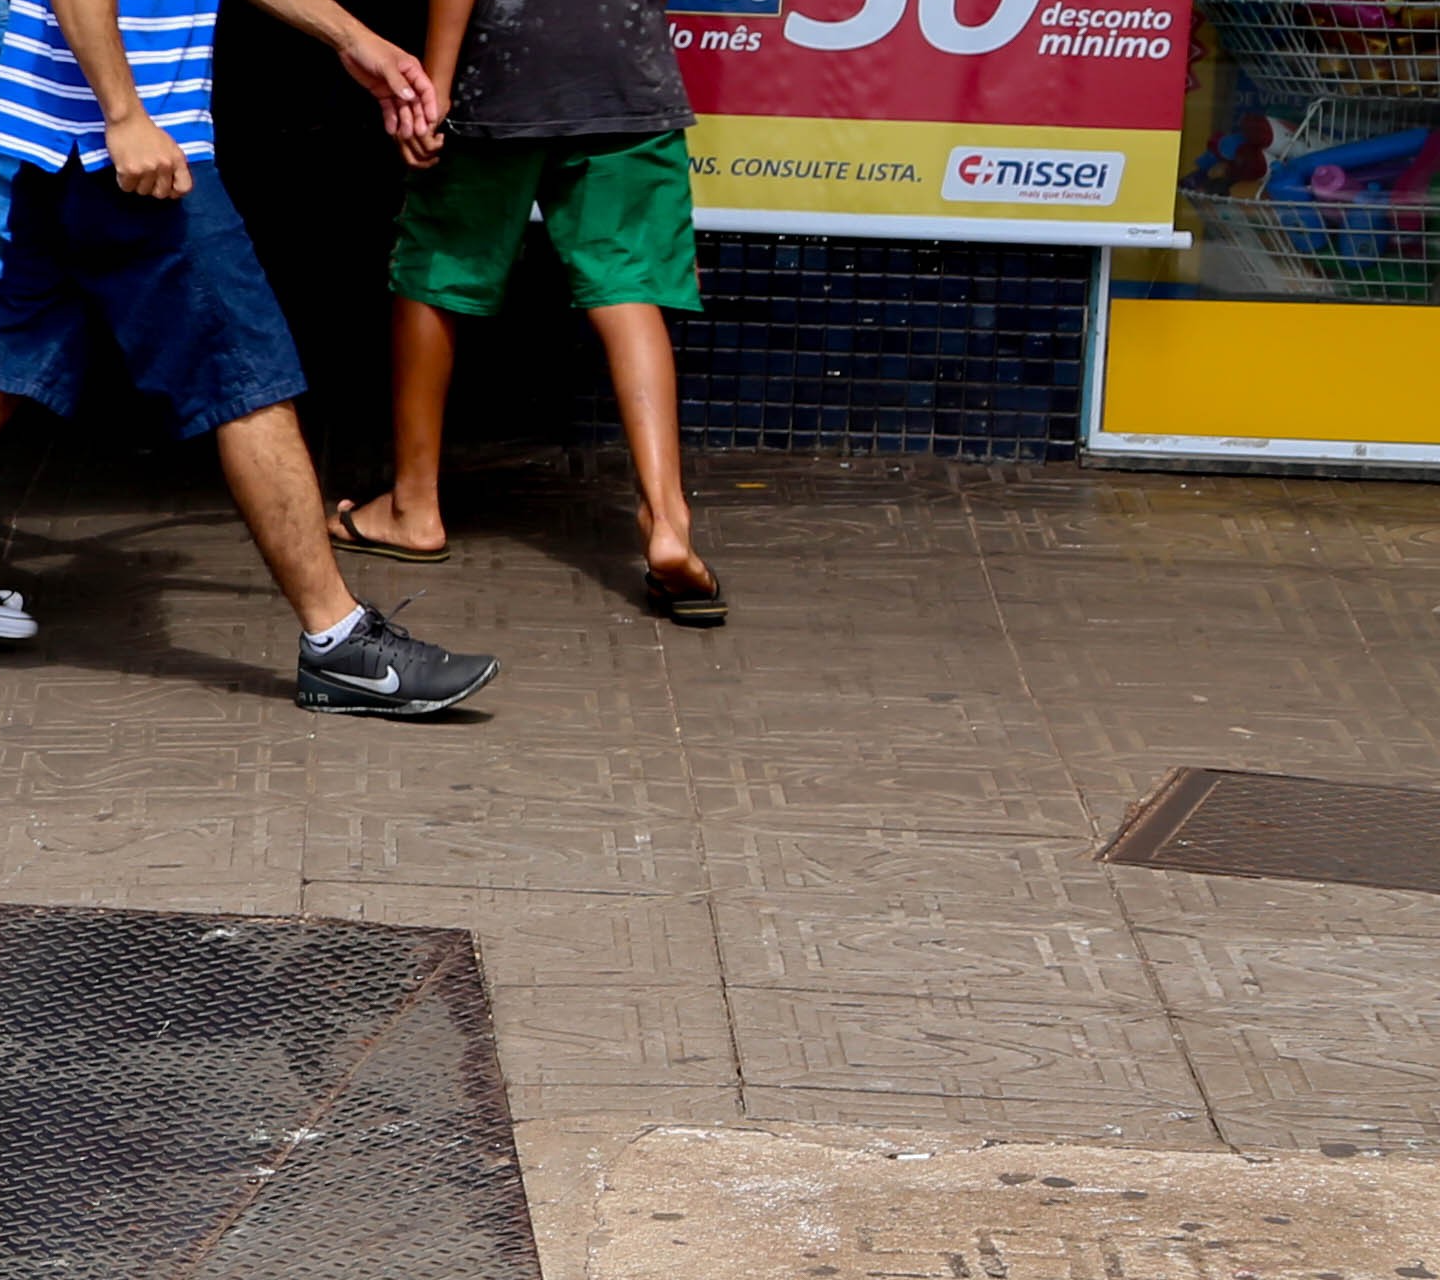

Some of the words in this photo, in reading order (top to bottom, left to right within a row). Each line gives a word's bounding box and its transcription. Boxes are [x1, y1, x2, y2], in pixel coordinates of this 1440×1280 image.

[1040, 2, 1171, 31] desconto
[700, 24, 762, 51] mês
[1038, 30, 1171, 60] mínimo
[730, 158, 850, 180] CONSULTE
[855, 163, 922, 183] LISTA.
[996, 160, 1108, 189] nissei
